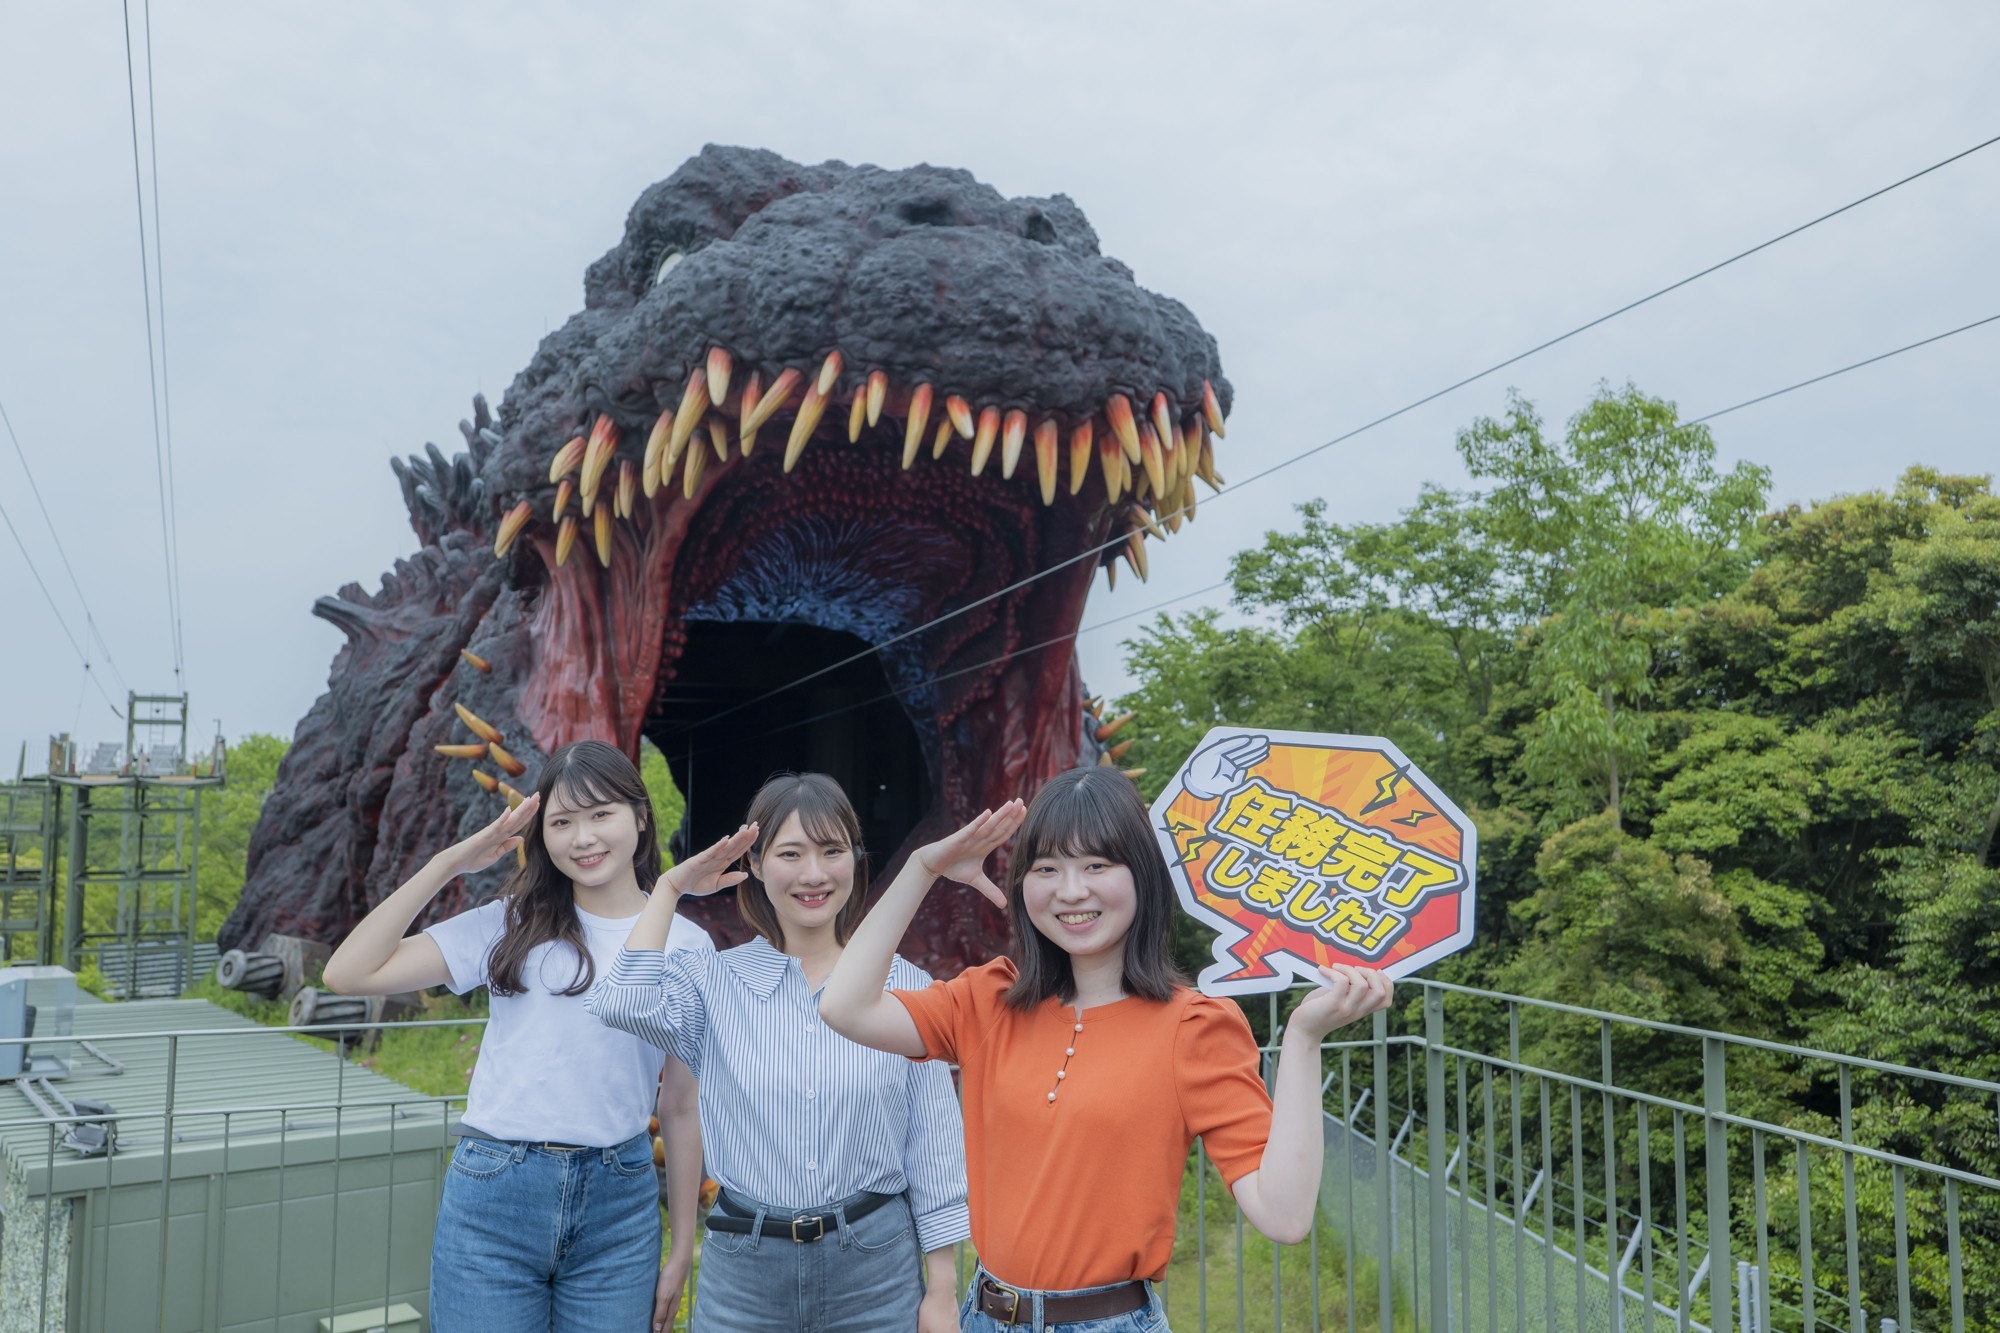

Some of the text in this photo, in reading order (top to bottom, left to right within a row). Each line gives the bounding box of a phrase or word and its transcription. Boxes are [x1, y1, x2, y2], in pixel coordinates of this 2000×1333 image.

[1211, 847, 1400, 950] しました!
[1213, 783, 1459, 907] 任務完了
